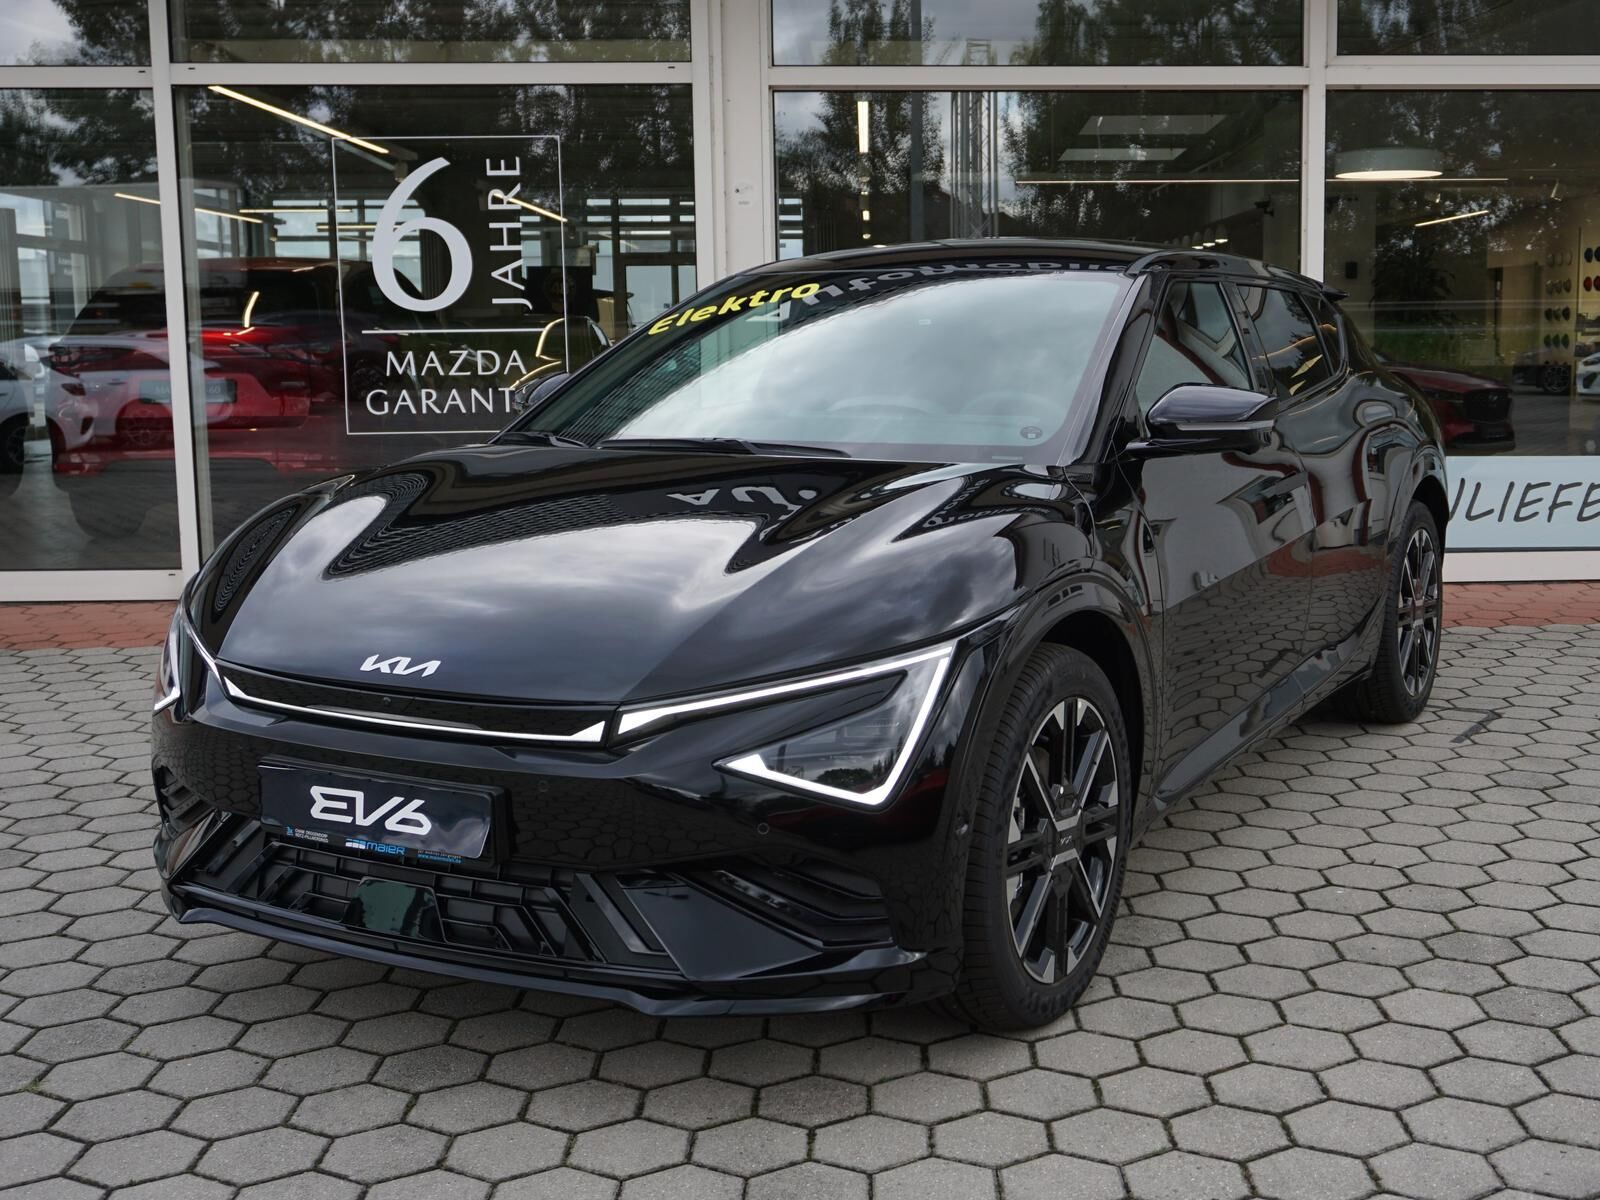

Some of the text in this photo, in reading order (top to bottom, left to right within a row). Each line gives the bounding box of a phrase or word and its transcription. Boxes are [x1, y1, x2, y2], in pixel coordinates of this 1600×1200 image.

[372, 156, 473, 312] 6
[485, 156, 533, 311] JAHRE
[648, 282, 820, 335] Elektro
[386, 350, 528, 377] MAZDA
[365, 387, 516, 415] GARANT
[310, 785, 433, 836] EV6
